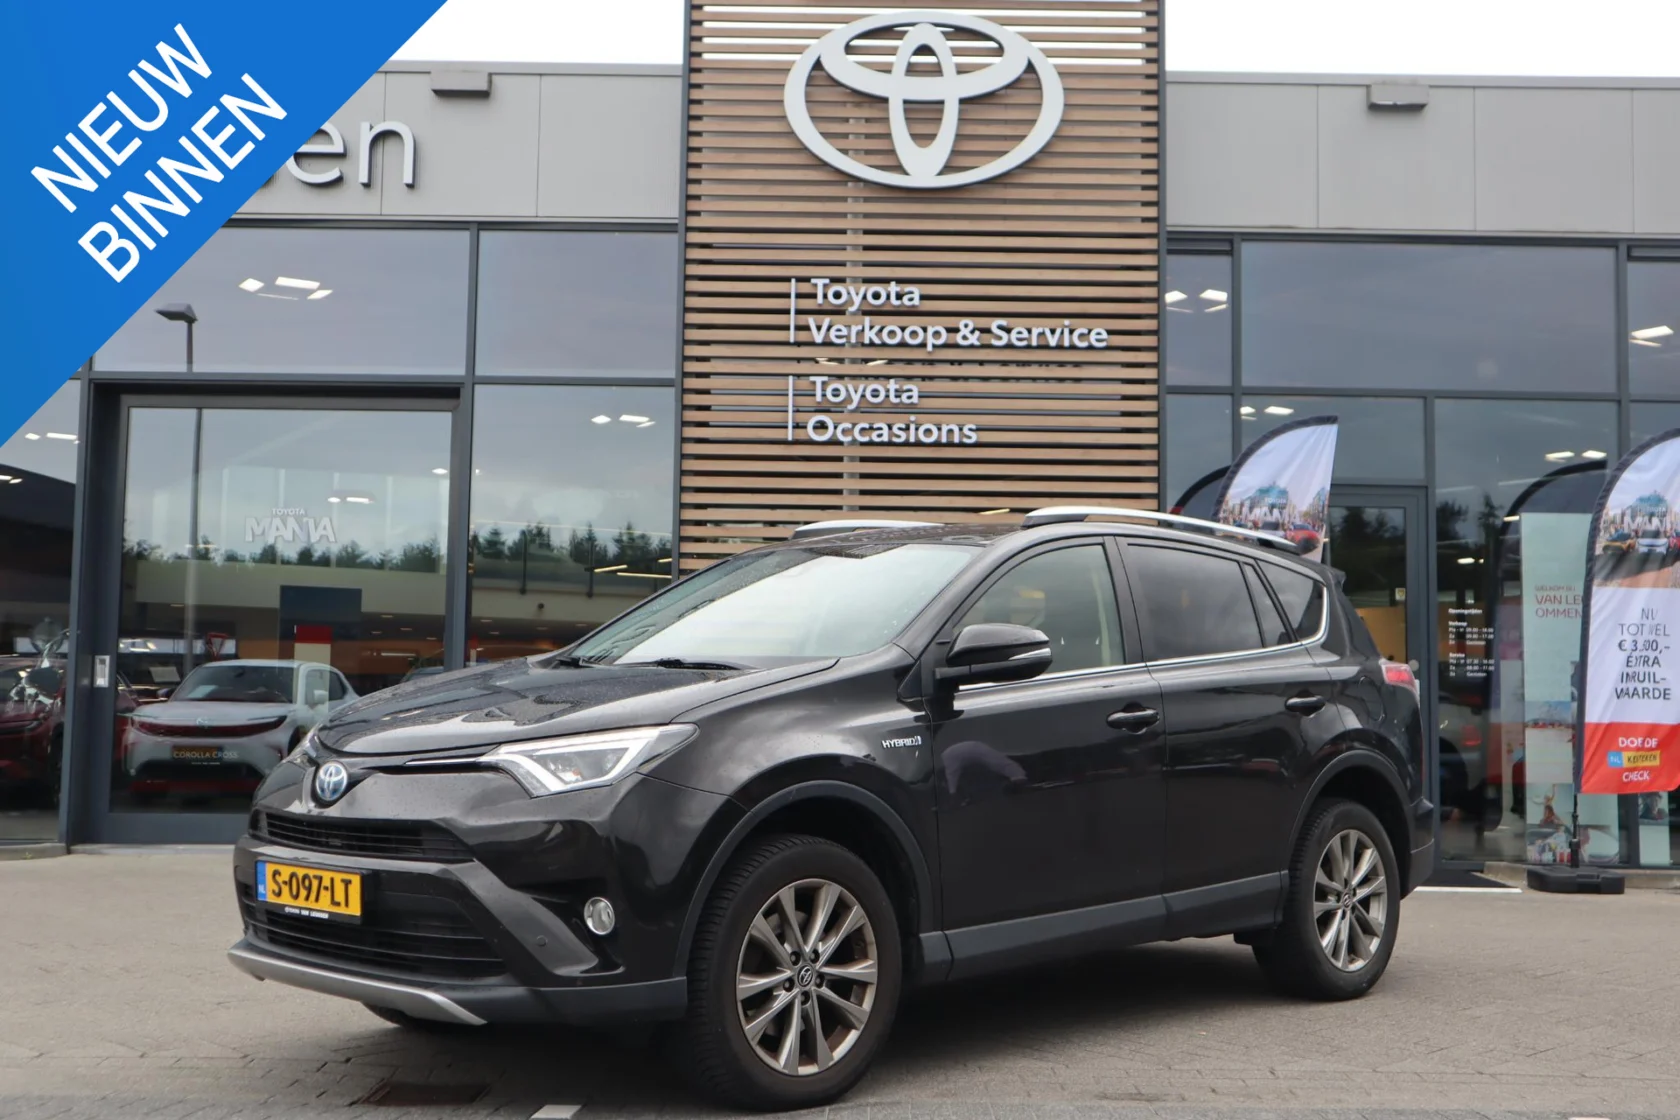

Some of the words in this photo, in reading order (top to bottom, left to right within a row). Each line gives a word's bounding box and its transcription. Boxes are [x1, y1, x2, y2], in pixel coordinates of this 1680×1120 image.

[810, 278, 921, 312] Toyota
[808, 317, 947, 351] Verkoop
[956, 320, 981, 346] &
[990, 320, 1109, 347] Service
[809, 376, 920, 410] Toyota
[806, 415, 978, 444] Occasions
[245, 516, 337, 543] MANIA
[1535, 594, 1562, 605] VAN
[1565, 594, 1583, 605] LE
[1535, 607, 1582, 618] OMMEN
[1641, 607, 1658, 620] NU
[1618, 623, 1646, 636] TOT
[1618, 639, 1627, 651] €
[881, 737, 916, 749] HYBRID
[1618, 737, 1643, 747] DOE
[173, 750, 210, 759] COROLLA
[212, 750, 238, 759] CROSS
[1622, 770, 1651, 782] CHECK
[271, 868, 352, 908] S-097-LT
